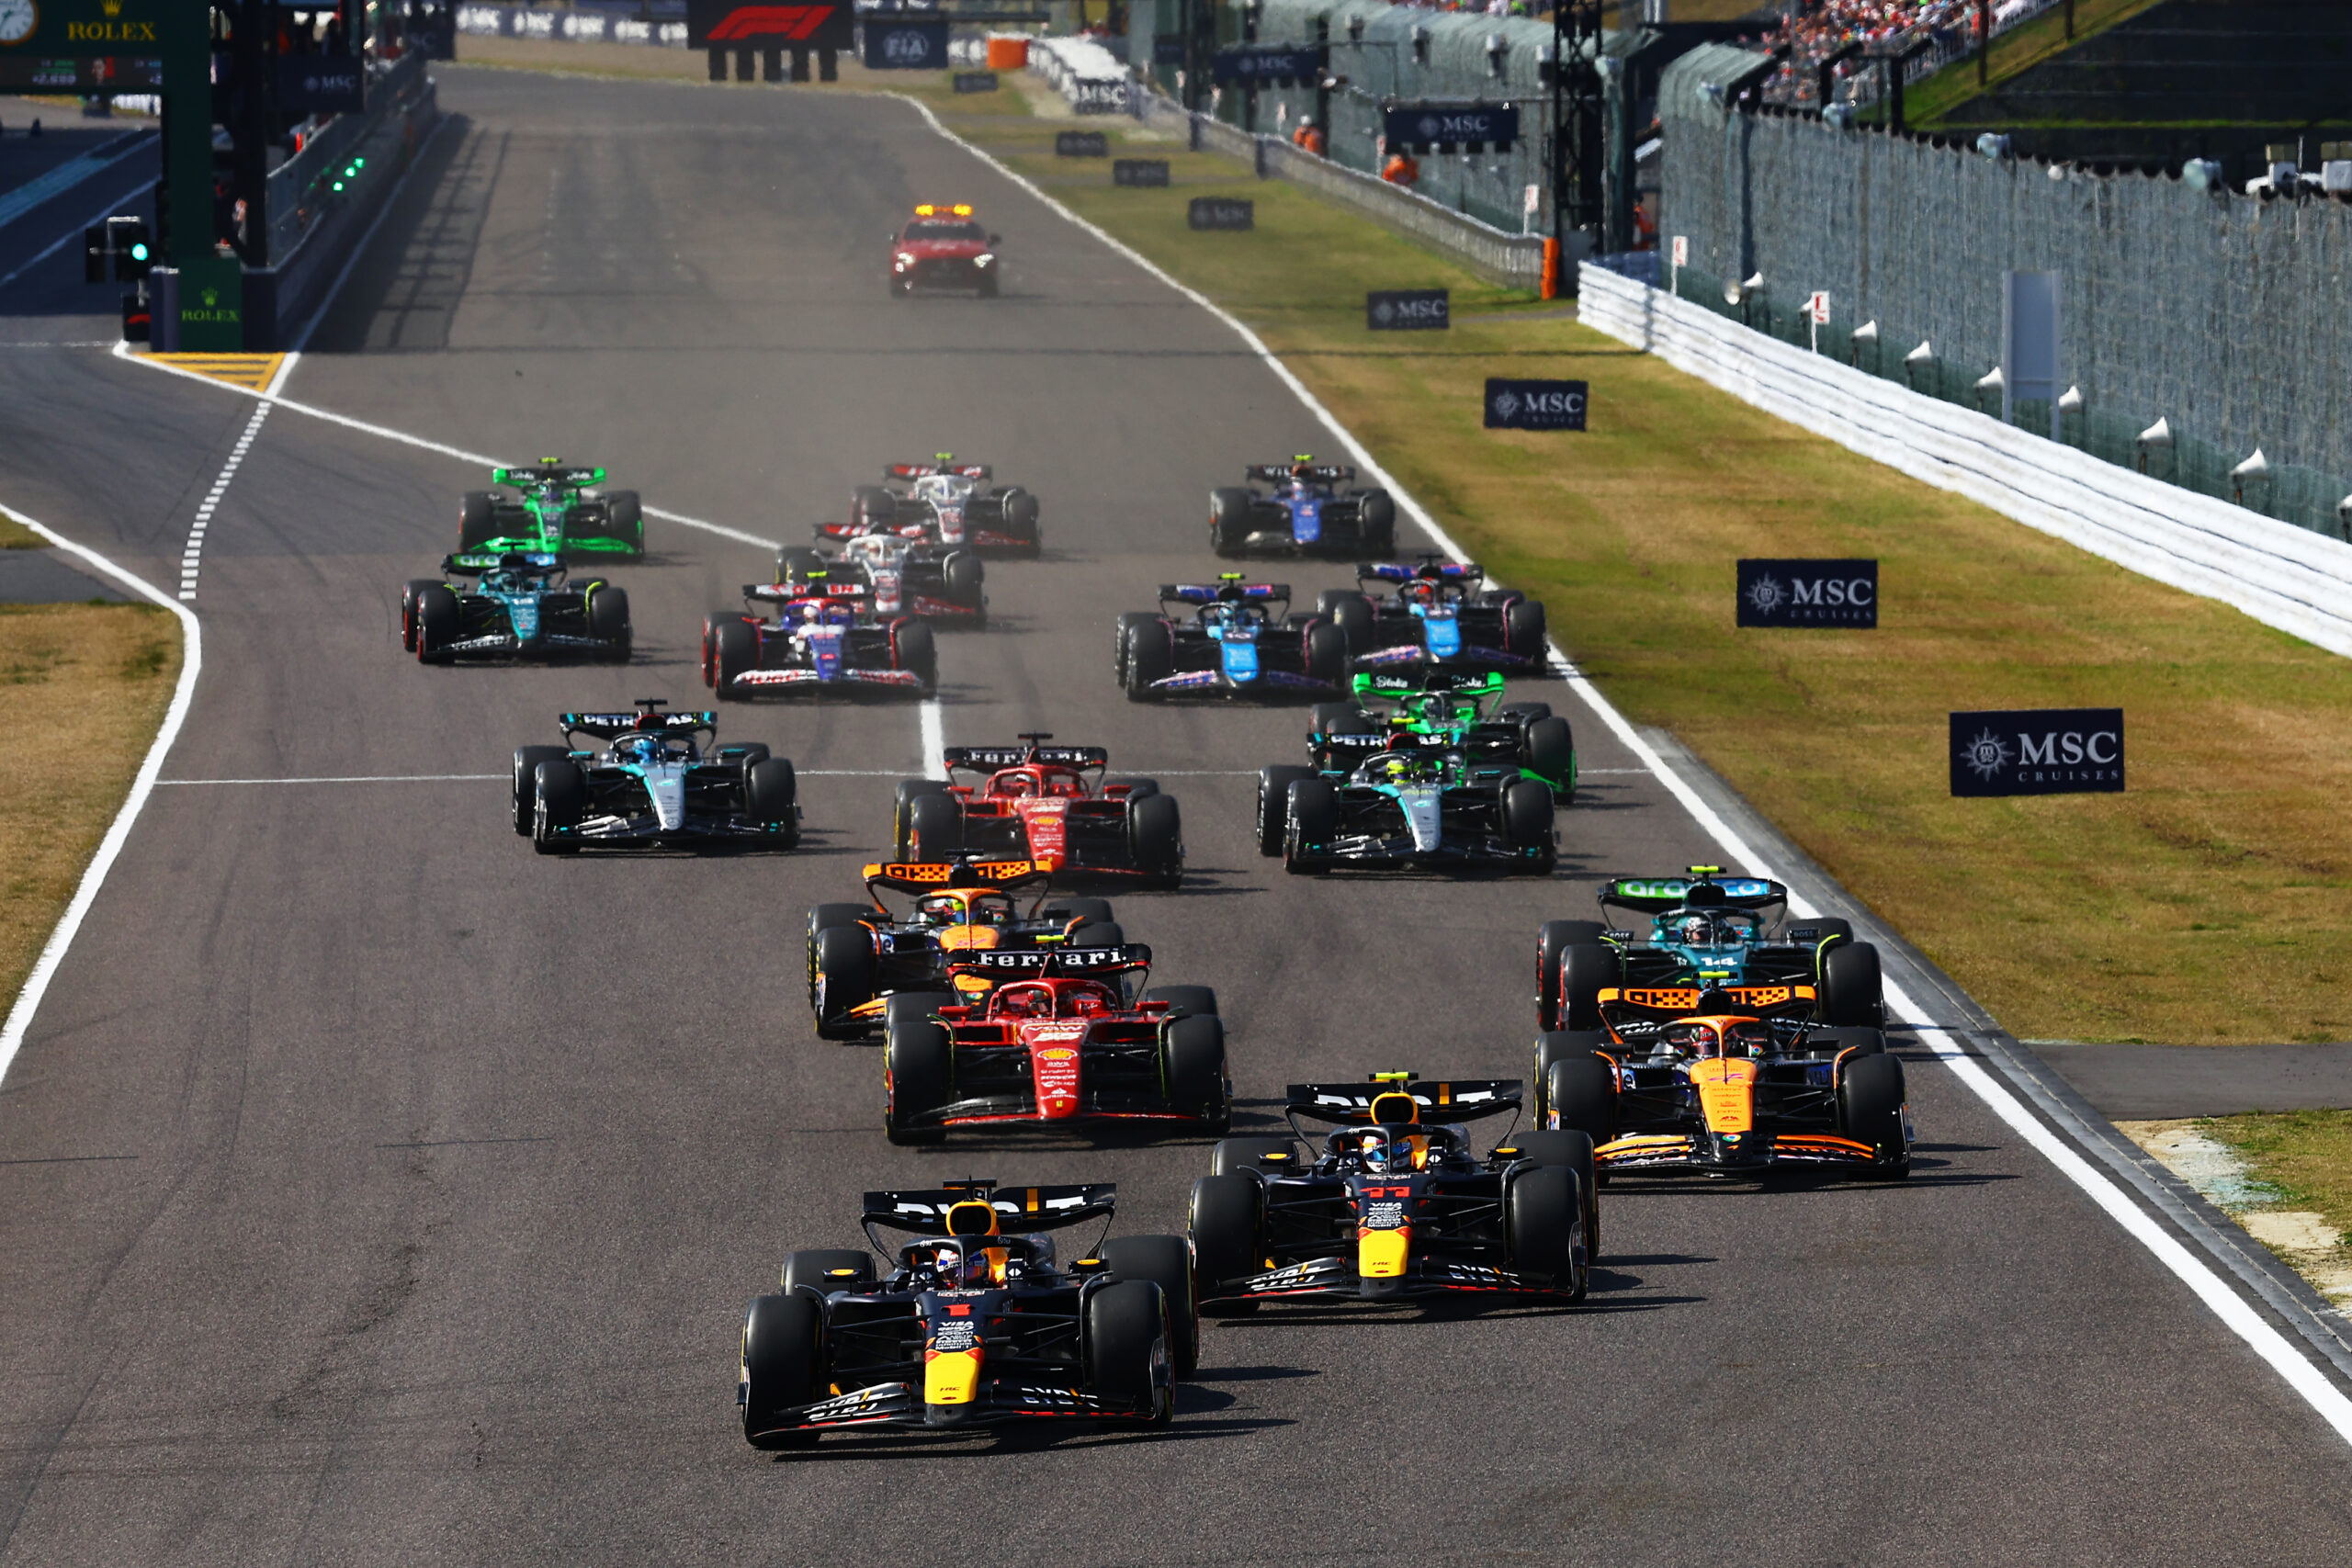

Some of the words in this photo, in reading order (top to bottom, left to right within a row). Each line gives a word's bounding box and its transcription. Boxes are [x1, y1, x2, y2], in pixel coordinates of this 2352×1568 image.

[67, 22, 156, 40] ROLEX
[1442, 116, 1491, 132] MSC
[182, 309, 239, 322] ROLEX
[1396, 299, 1446, 318] MSC
[1523, 391, 1584, 413] MSC
[1792, 578, 1873, 605] MSC
[583, 714, 693, 727] PETRAS
[1330, 734, 1442, 747] PETRAS
[2017, 731, 2118, 766] MSC
[2018, 770, 2119, 782] CRUISES
[1625, 881, 1761, 897] araco
[1701, 957, 1737, 966] 14
[1359, 1186, 1411, 1199] 11
